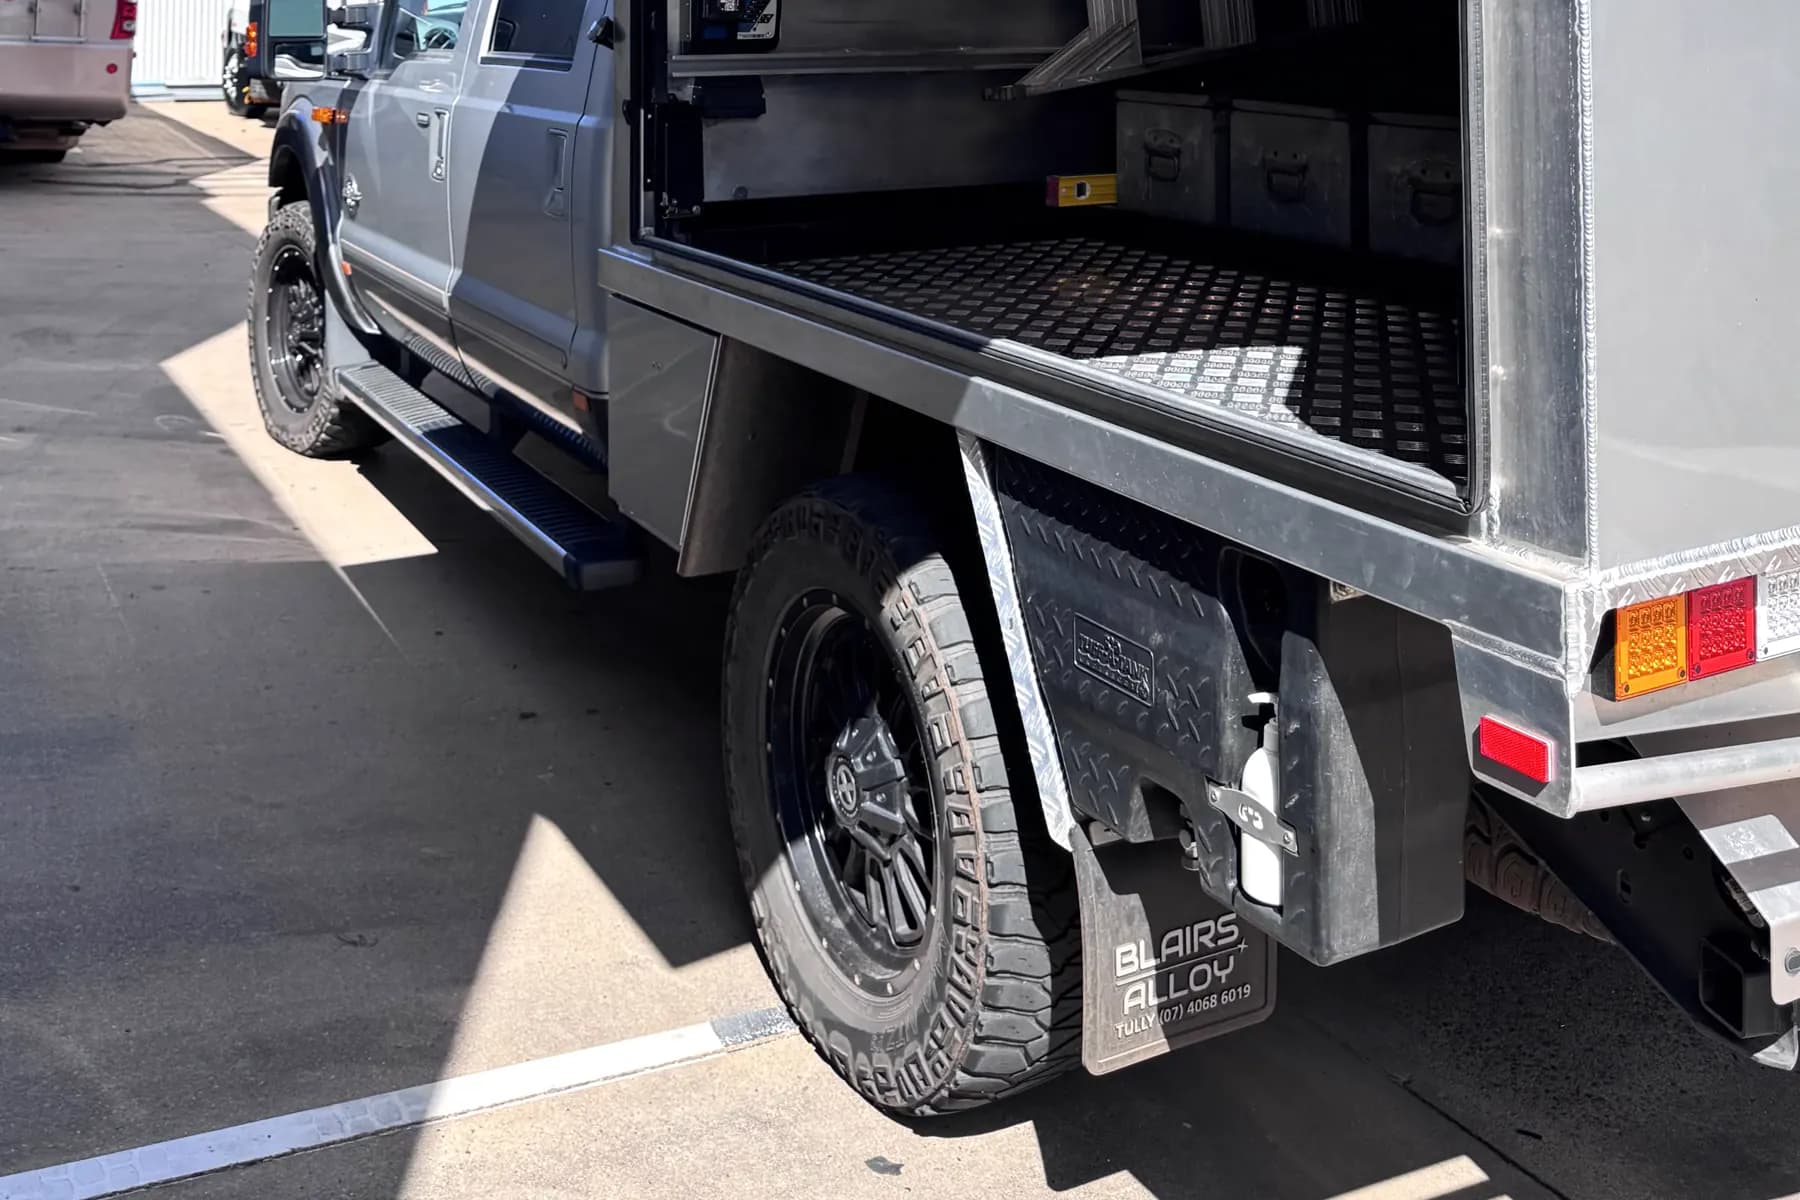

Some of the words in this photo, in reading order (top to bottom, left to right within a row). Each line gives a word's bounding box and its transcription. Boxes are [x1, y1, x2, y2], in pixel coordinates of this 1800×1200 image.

[1114, 912, 1240, 978] BLAIRS
[1115, 1013, 1156, 1039] TULLY
[1159, 1003, 1184, 1025] (07)
[1187, 993, 1218, 1014] 4068
[1221, 983, 1252, 1005] 6019
[1122, 954, 1235, 1016] ALLOY
